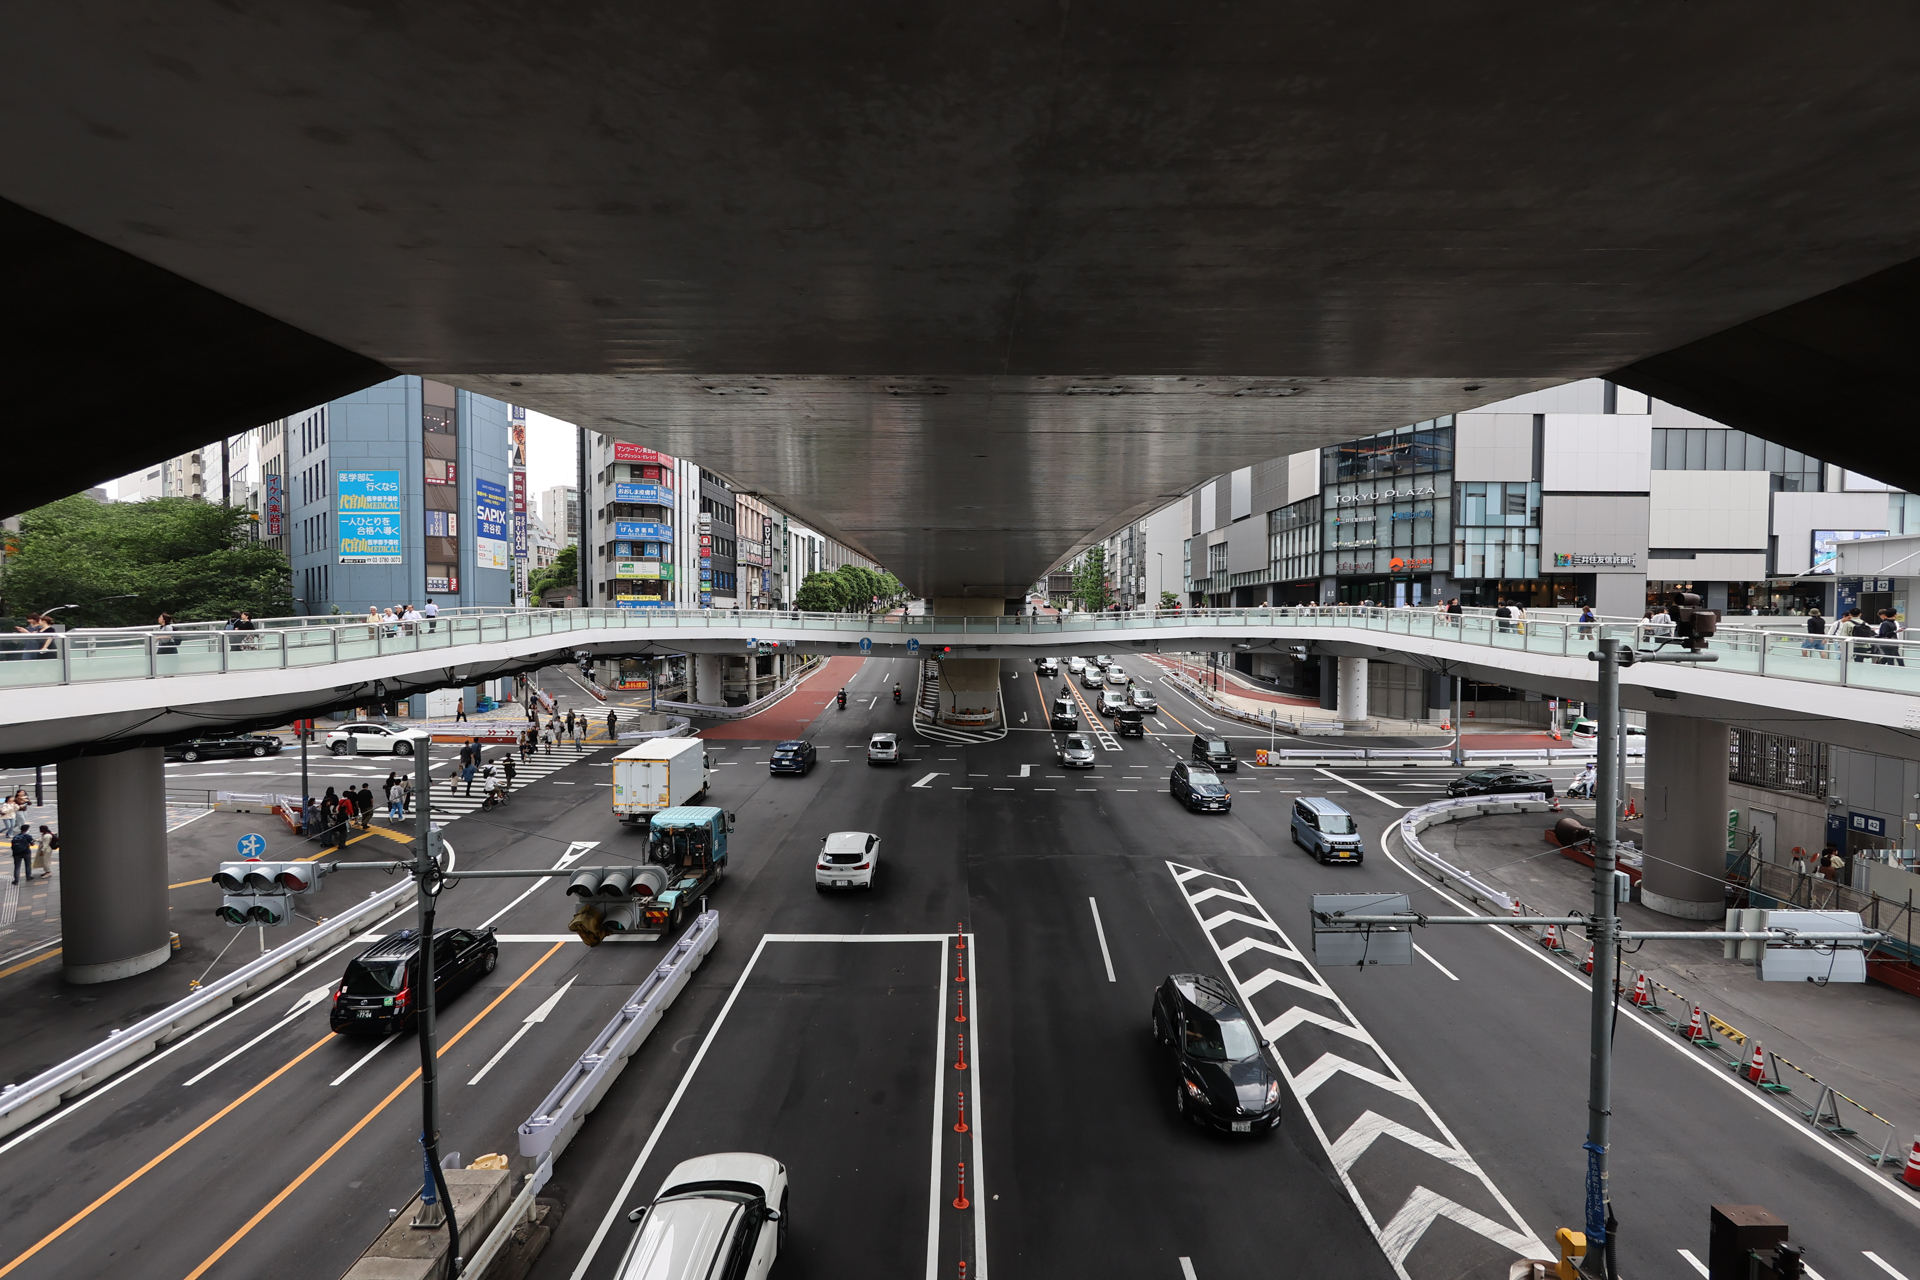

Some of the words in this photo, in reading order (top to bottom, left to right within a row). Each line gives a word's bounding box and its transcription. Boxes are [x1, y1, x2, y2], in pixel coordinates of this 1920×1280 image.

[339, 473, 374, 482] 医学部に
[366, 483, 398, 491] 行くなら
[269, 477, 280, 523] イケベ楽器
[1334, 493, 1379, 503] TOKYU
[1385, 487, 1435, 498] PLAZA
[340, 494, 367, 509] 代官山
[477, 505, 506, 524] SAPIX
[341, 517, 390, 526] 一人ひとりを
[357, 527, 399, 535] 合格へ導く
[483, 522, 501, 535] 渋谷校
[341, 538, 368, 552] 代官山
[618, 543, 629, 554] 薬
[646, 544, 657, 555] 局
[1574, 556, 1636, 564] 三井住友信託銀行
[451, 578, 456, 590] 3F
